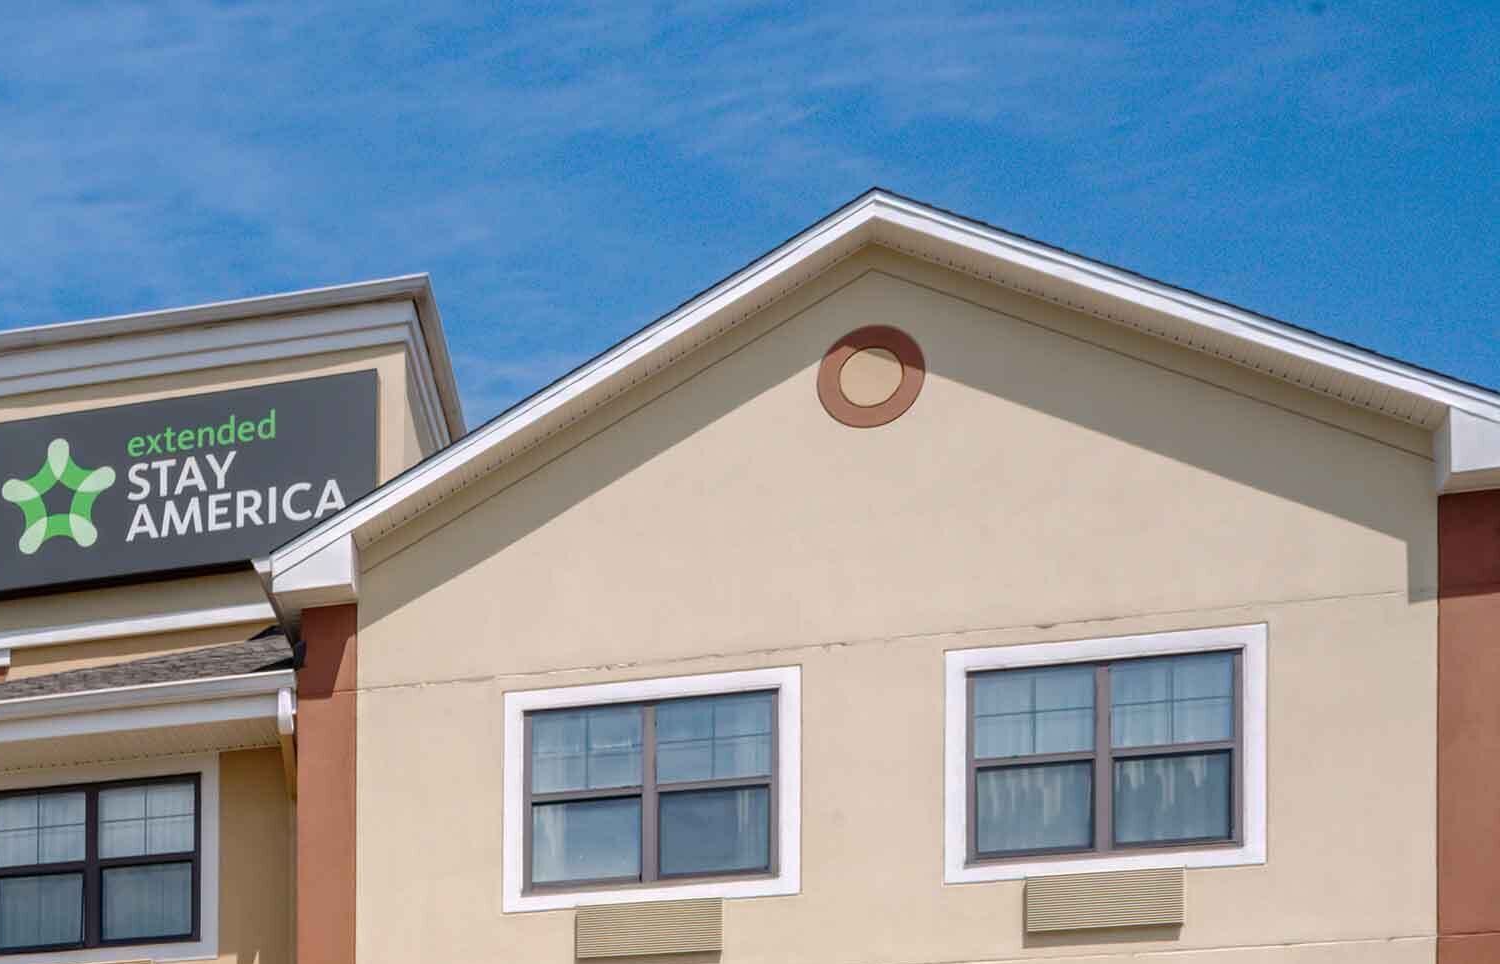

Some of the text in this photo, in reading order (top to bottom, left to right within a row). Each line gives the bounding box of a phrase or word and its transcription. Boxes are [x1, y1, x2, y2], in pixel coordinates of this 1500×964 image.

[127, 409, 276, 457] extended
[127, 450, 237, 500] STAY
[126, 479, 347, 542] AMERICA
